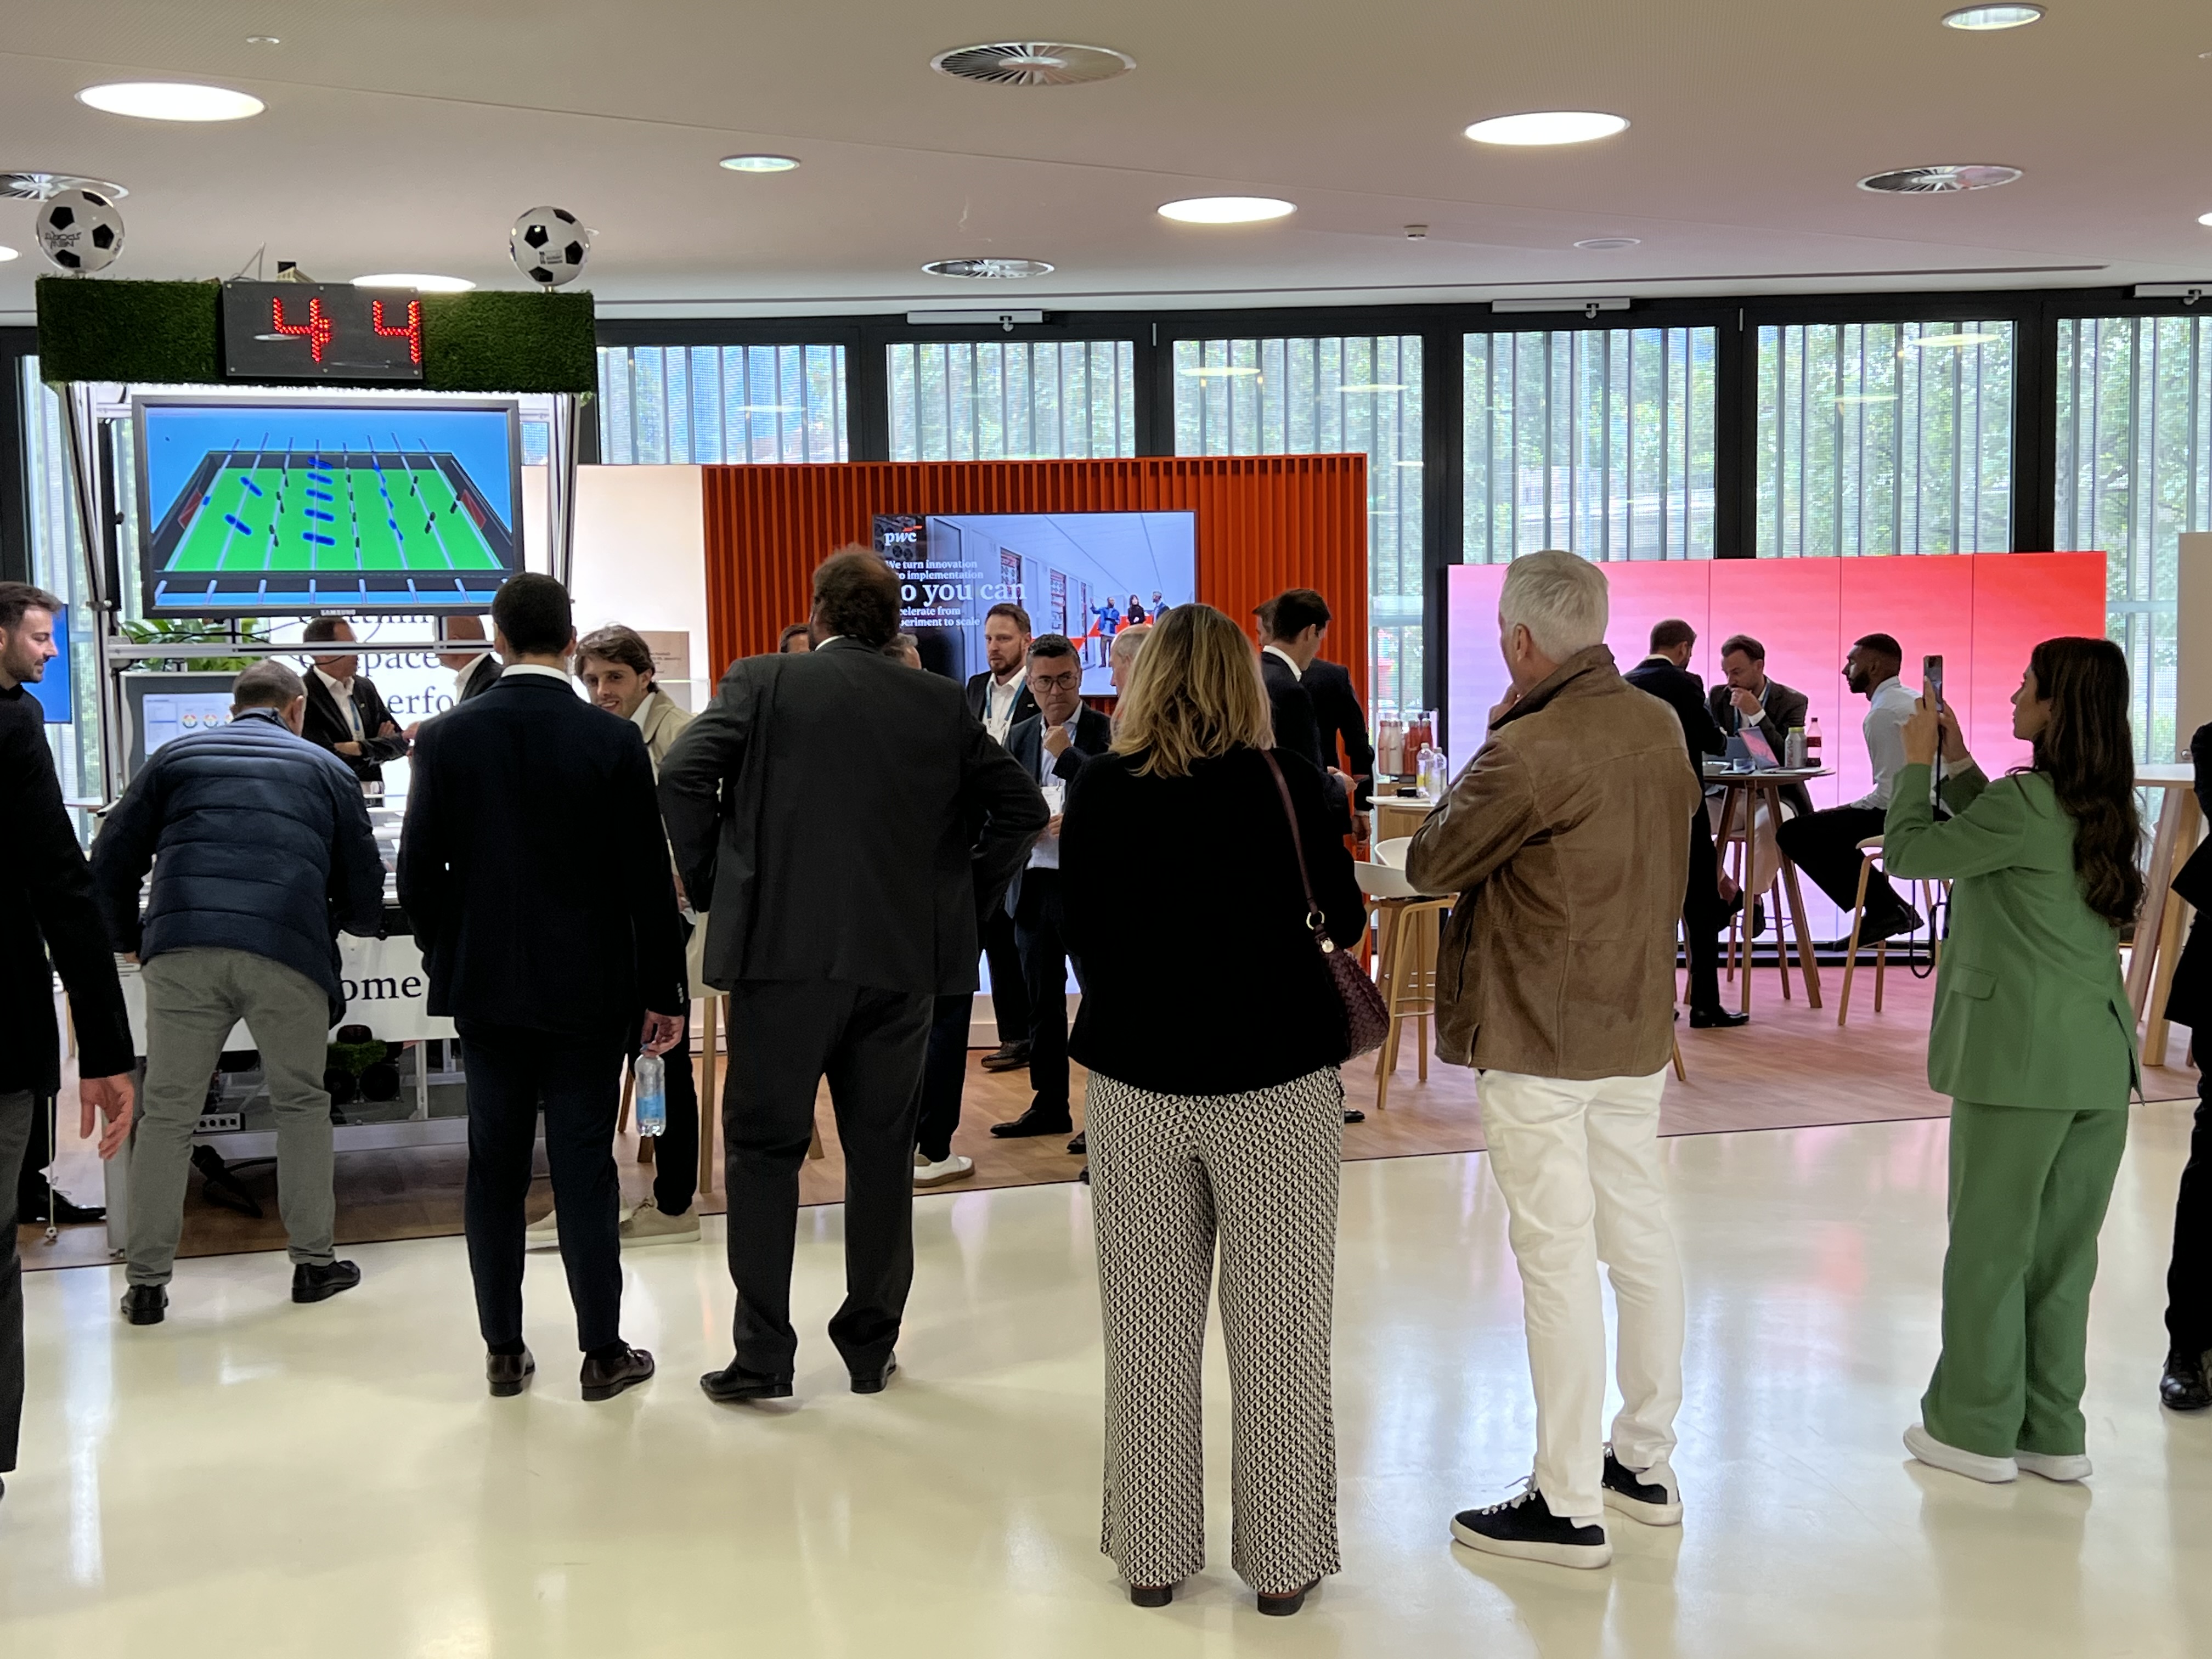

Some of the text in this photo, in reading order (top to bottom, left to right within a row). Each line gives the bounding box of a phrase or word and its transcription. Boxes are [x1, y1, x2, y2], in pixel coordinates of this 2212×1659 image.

[372, 300, 421, 364] 4
[884, 532, 917, 546] pwc
[885, 560, 978, 569] We turn innovation
[907, 570, 984, 582] implementation
[901, 583, 1027, 606] o you can
[937, 605, 961, 616] from
[944, 618, 955, 627] to
[956, 617, 980, 627] scale
[357, 652, 441, 678] pace
[387, 685, 454, 714] erfo
[341, 976, 422, 1001] ome
